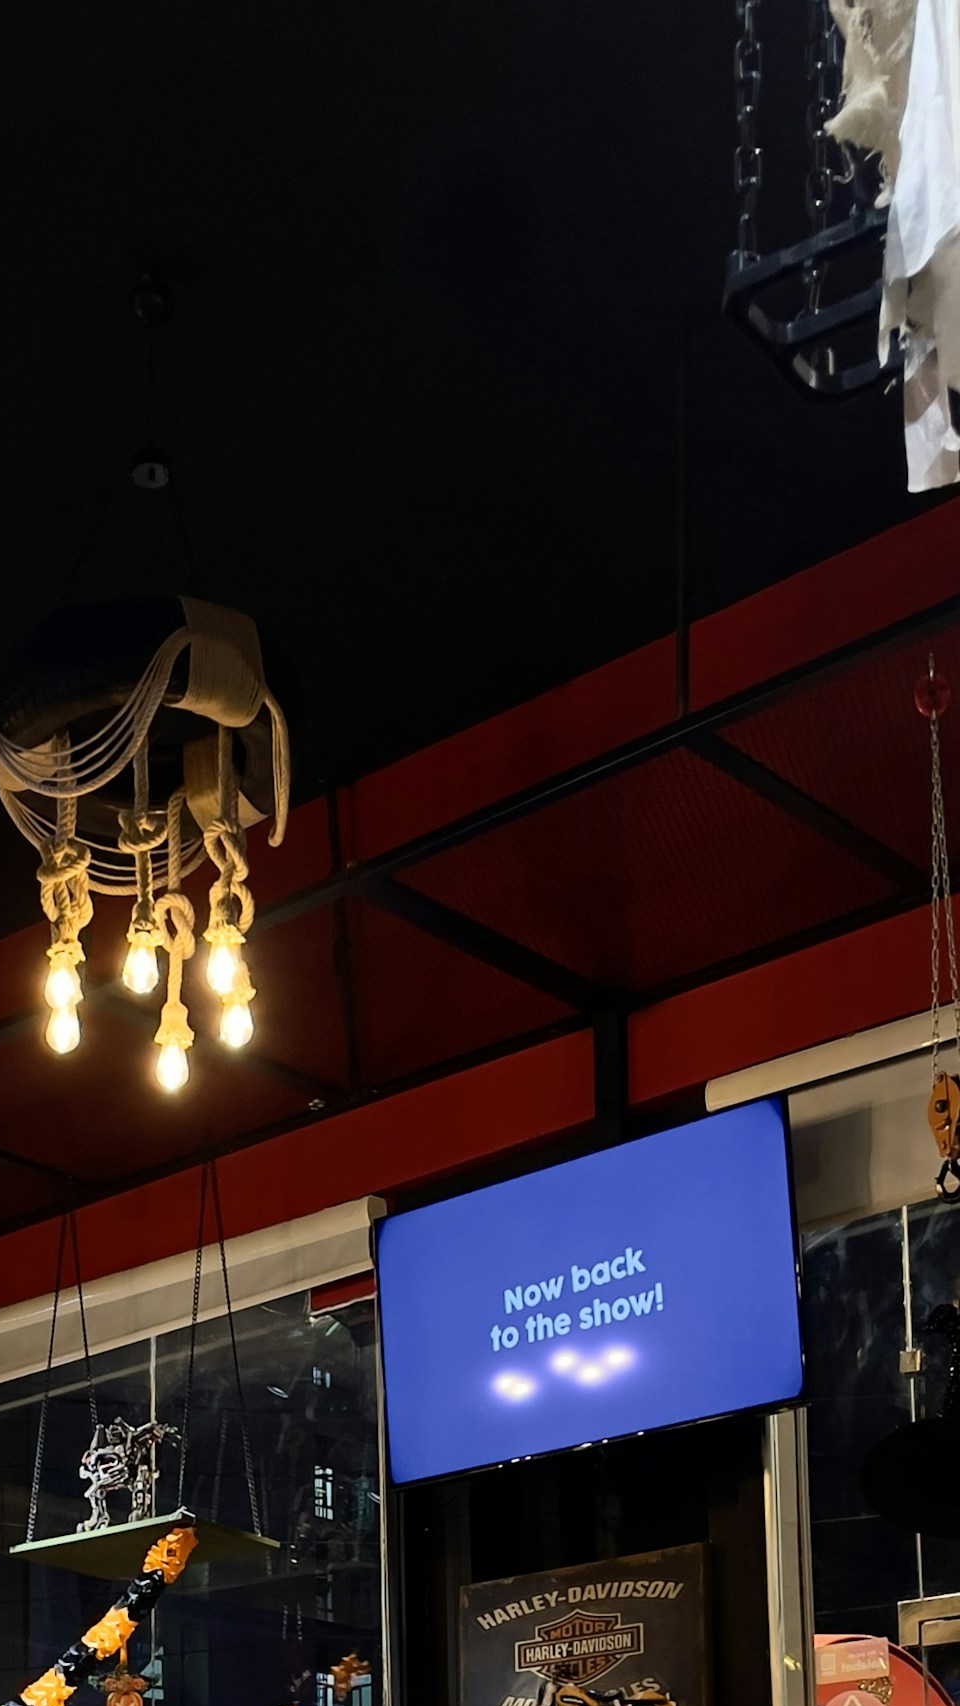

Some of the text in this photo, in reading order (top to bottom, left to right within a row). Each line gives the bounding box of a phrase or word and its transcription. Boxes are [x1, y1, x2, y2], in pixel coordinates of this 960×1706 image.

[503, 1247, 647, 1315] Now back
[490, 1282, 664, 1352] to the show!
[476, 1580, 685, 1631] HARLEY-DAVIDSON
[549, 1619, 607, 1640] MOTOR
[525, 1633, 633, 1663] HARLEY-DAVIDSON
